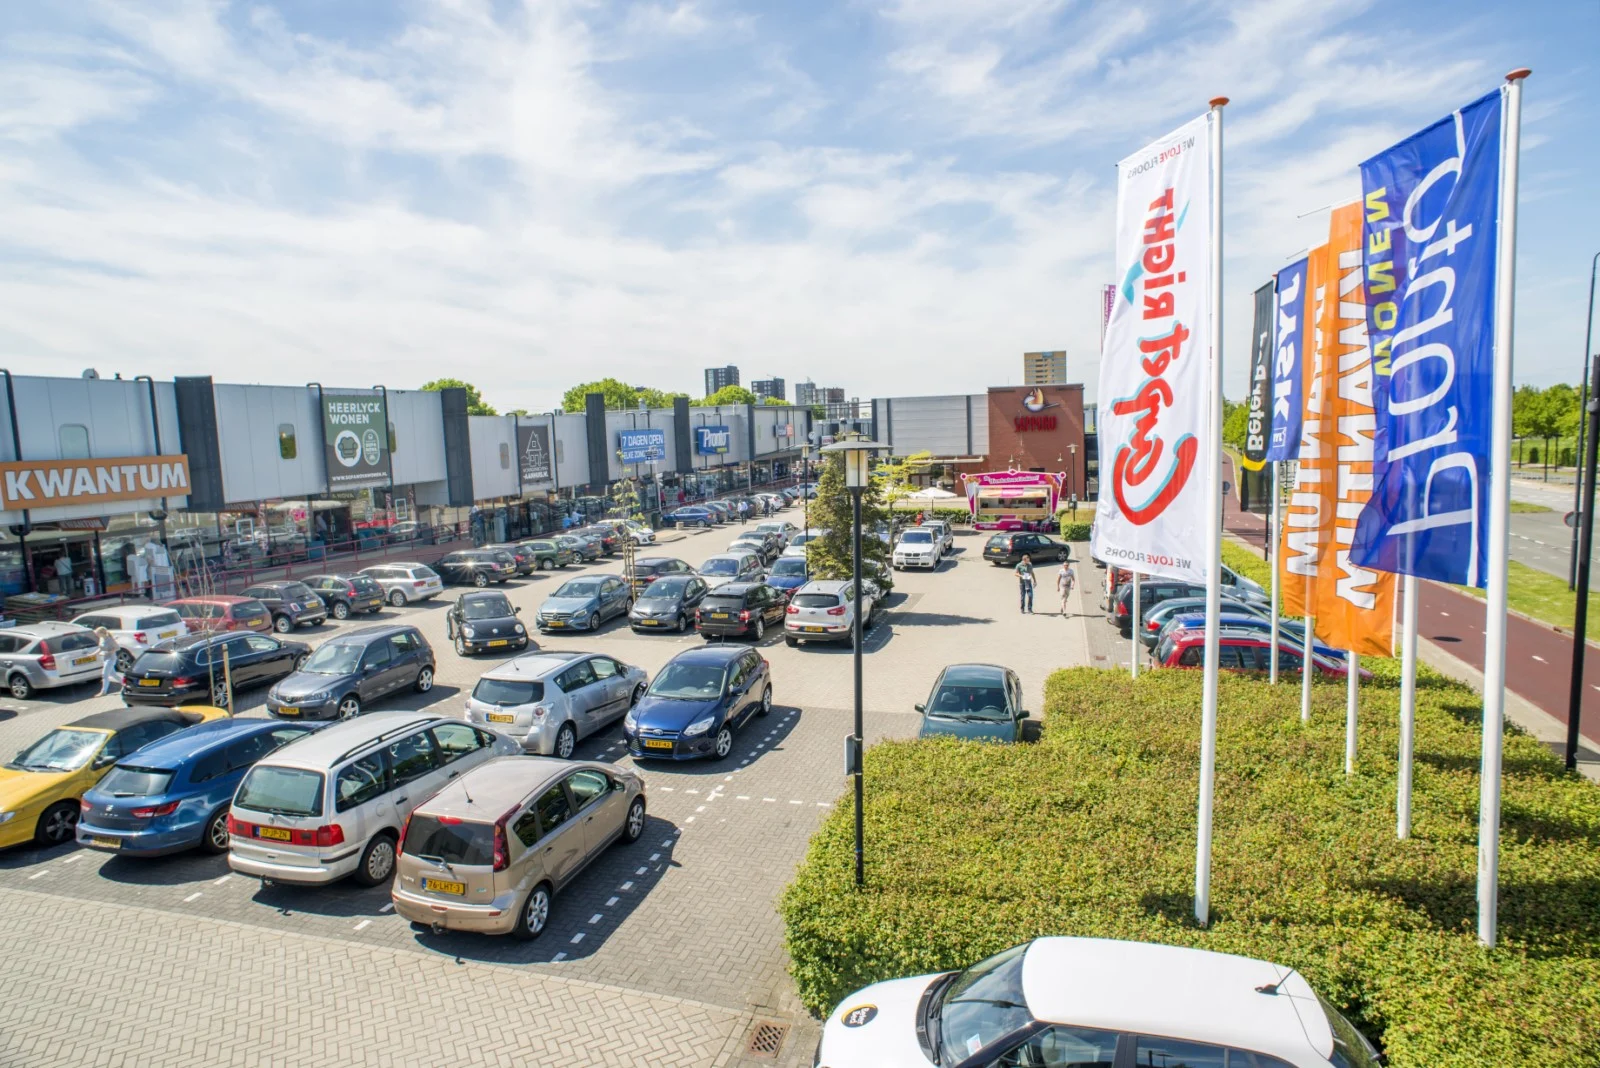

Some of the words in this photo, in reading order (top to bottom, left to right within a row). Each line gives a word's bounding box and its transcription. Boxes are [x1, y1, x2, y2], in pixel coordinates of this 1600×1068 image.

[328, 402, 380, 413] HEERLYCK
[329, 413, 370, 424] WONEN
[622, 436, 627, 446] 7
[628, 435, 648, 446] DAGEN
[649, 434, 664, 444] OPEN
[698, 429, 731, 448] Pronto
[4, 462, 188, 501] KWANTUM
[60, 519, 101, 529] KWANTUM
